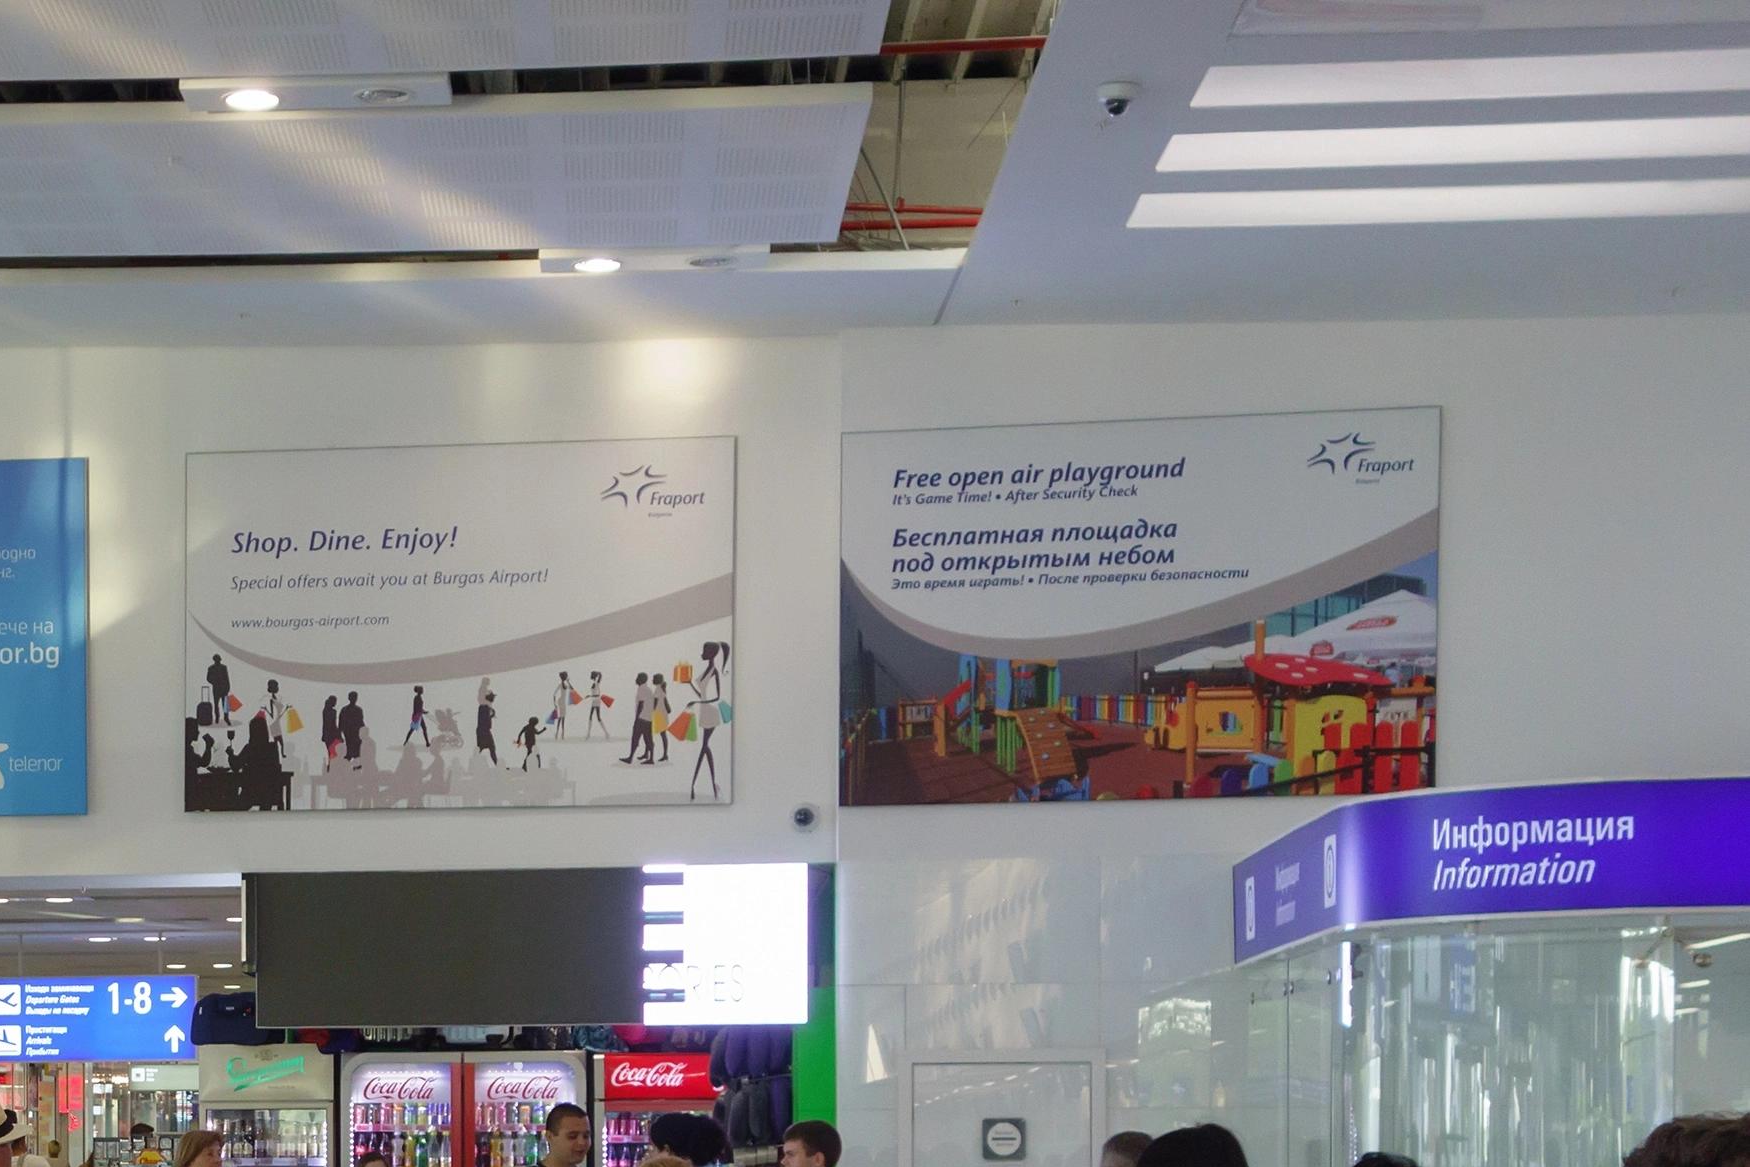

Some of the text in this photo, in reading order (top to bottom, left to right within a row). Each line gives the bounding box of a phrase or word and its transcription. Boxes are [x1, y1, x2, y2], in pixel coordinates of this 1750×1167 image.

[894, 458, 1185, 492] Free open air playground
[1357, 457, 1414, 477] Fraport
[650, 490, 705, 508] Fraport
[893, 484, 1138, 505] It's Game Time! After Security Check
[232, 526, 458, 559] Shop. Dine. Enjoy!
[893, 519, 1177, 548] Бесплатная площадка
[892, 543, 1174, 574] под открытым небом
[231, 569, 548, 593] Special offers await you at Burgas Airport!
[892, 567, 1249, 591] Это время играть! После проверки безопасности
[32, 620, 54, 635] на
[231, 613, 390, 631] www.bourgas-airport.com
[8, 755, 63, 773] telenor
[1432, 816, 1634, 854] Информация
[1432, 854, 1596, 891] Information
[107, 981, 152, 1015] 1-8
[611, 1062, 688, 1087] Coca-Cola
[364, 1076, 434, 1101] Coca-Cola
[487, 1076, 558, 1101] Coca-Cola
